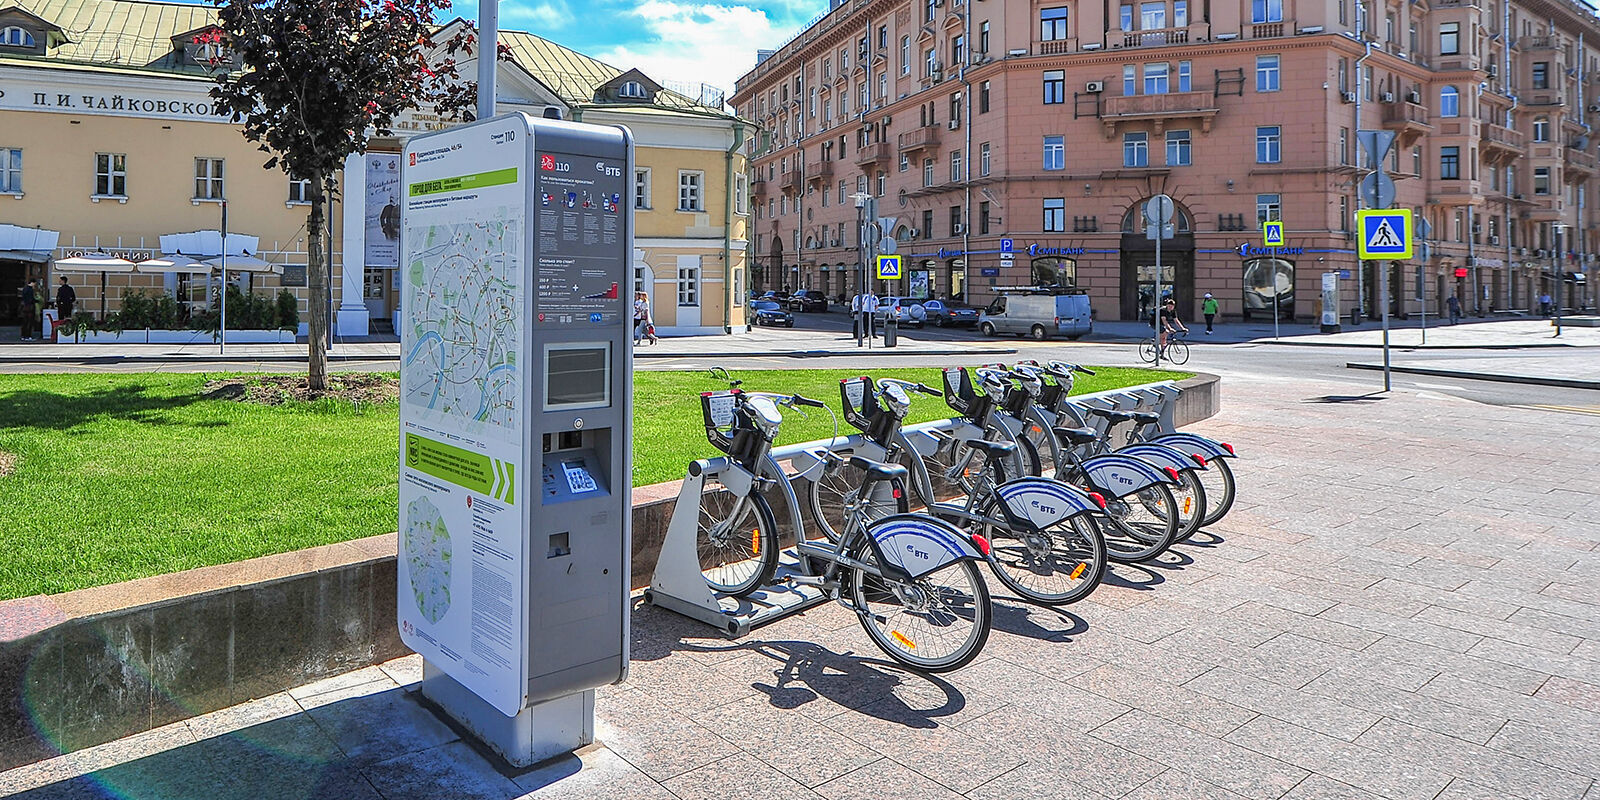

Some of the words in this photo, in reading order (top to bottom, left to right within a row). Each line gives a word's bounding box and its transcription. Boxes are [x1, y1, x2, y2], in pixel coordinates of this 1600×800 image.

[505, 130, 516, 142] 110
[556, 162, 570, 172] 110
[606, 167, 620, 176] ВТБ
[1276, 247, 1304, 256] БАНК
[1120, 476, 1133, 486] ВТБ
[1040, 504, 1056, 514] ВТБ
[914, 550, 928, 560] ВТБ
